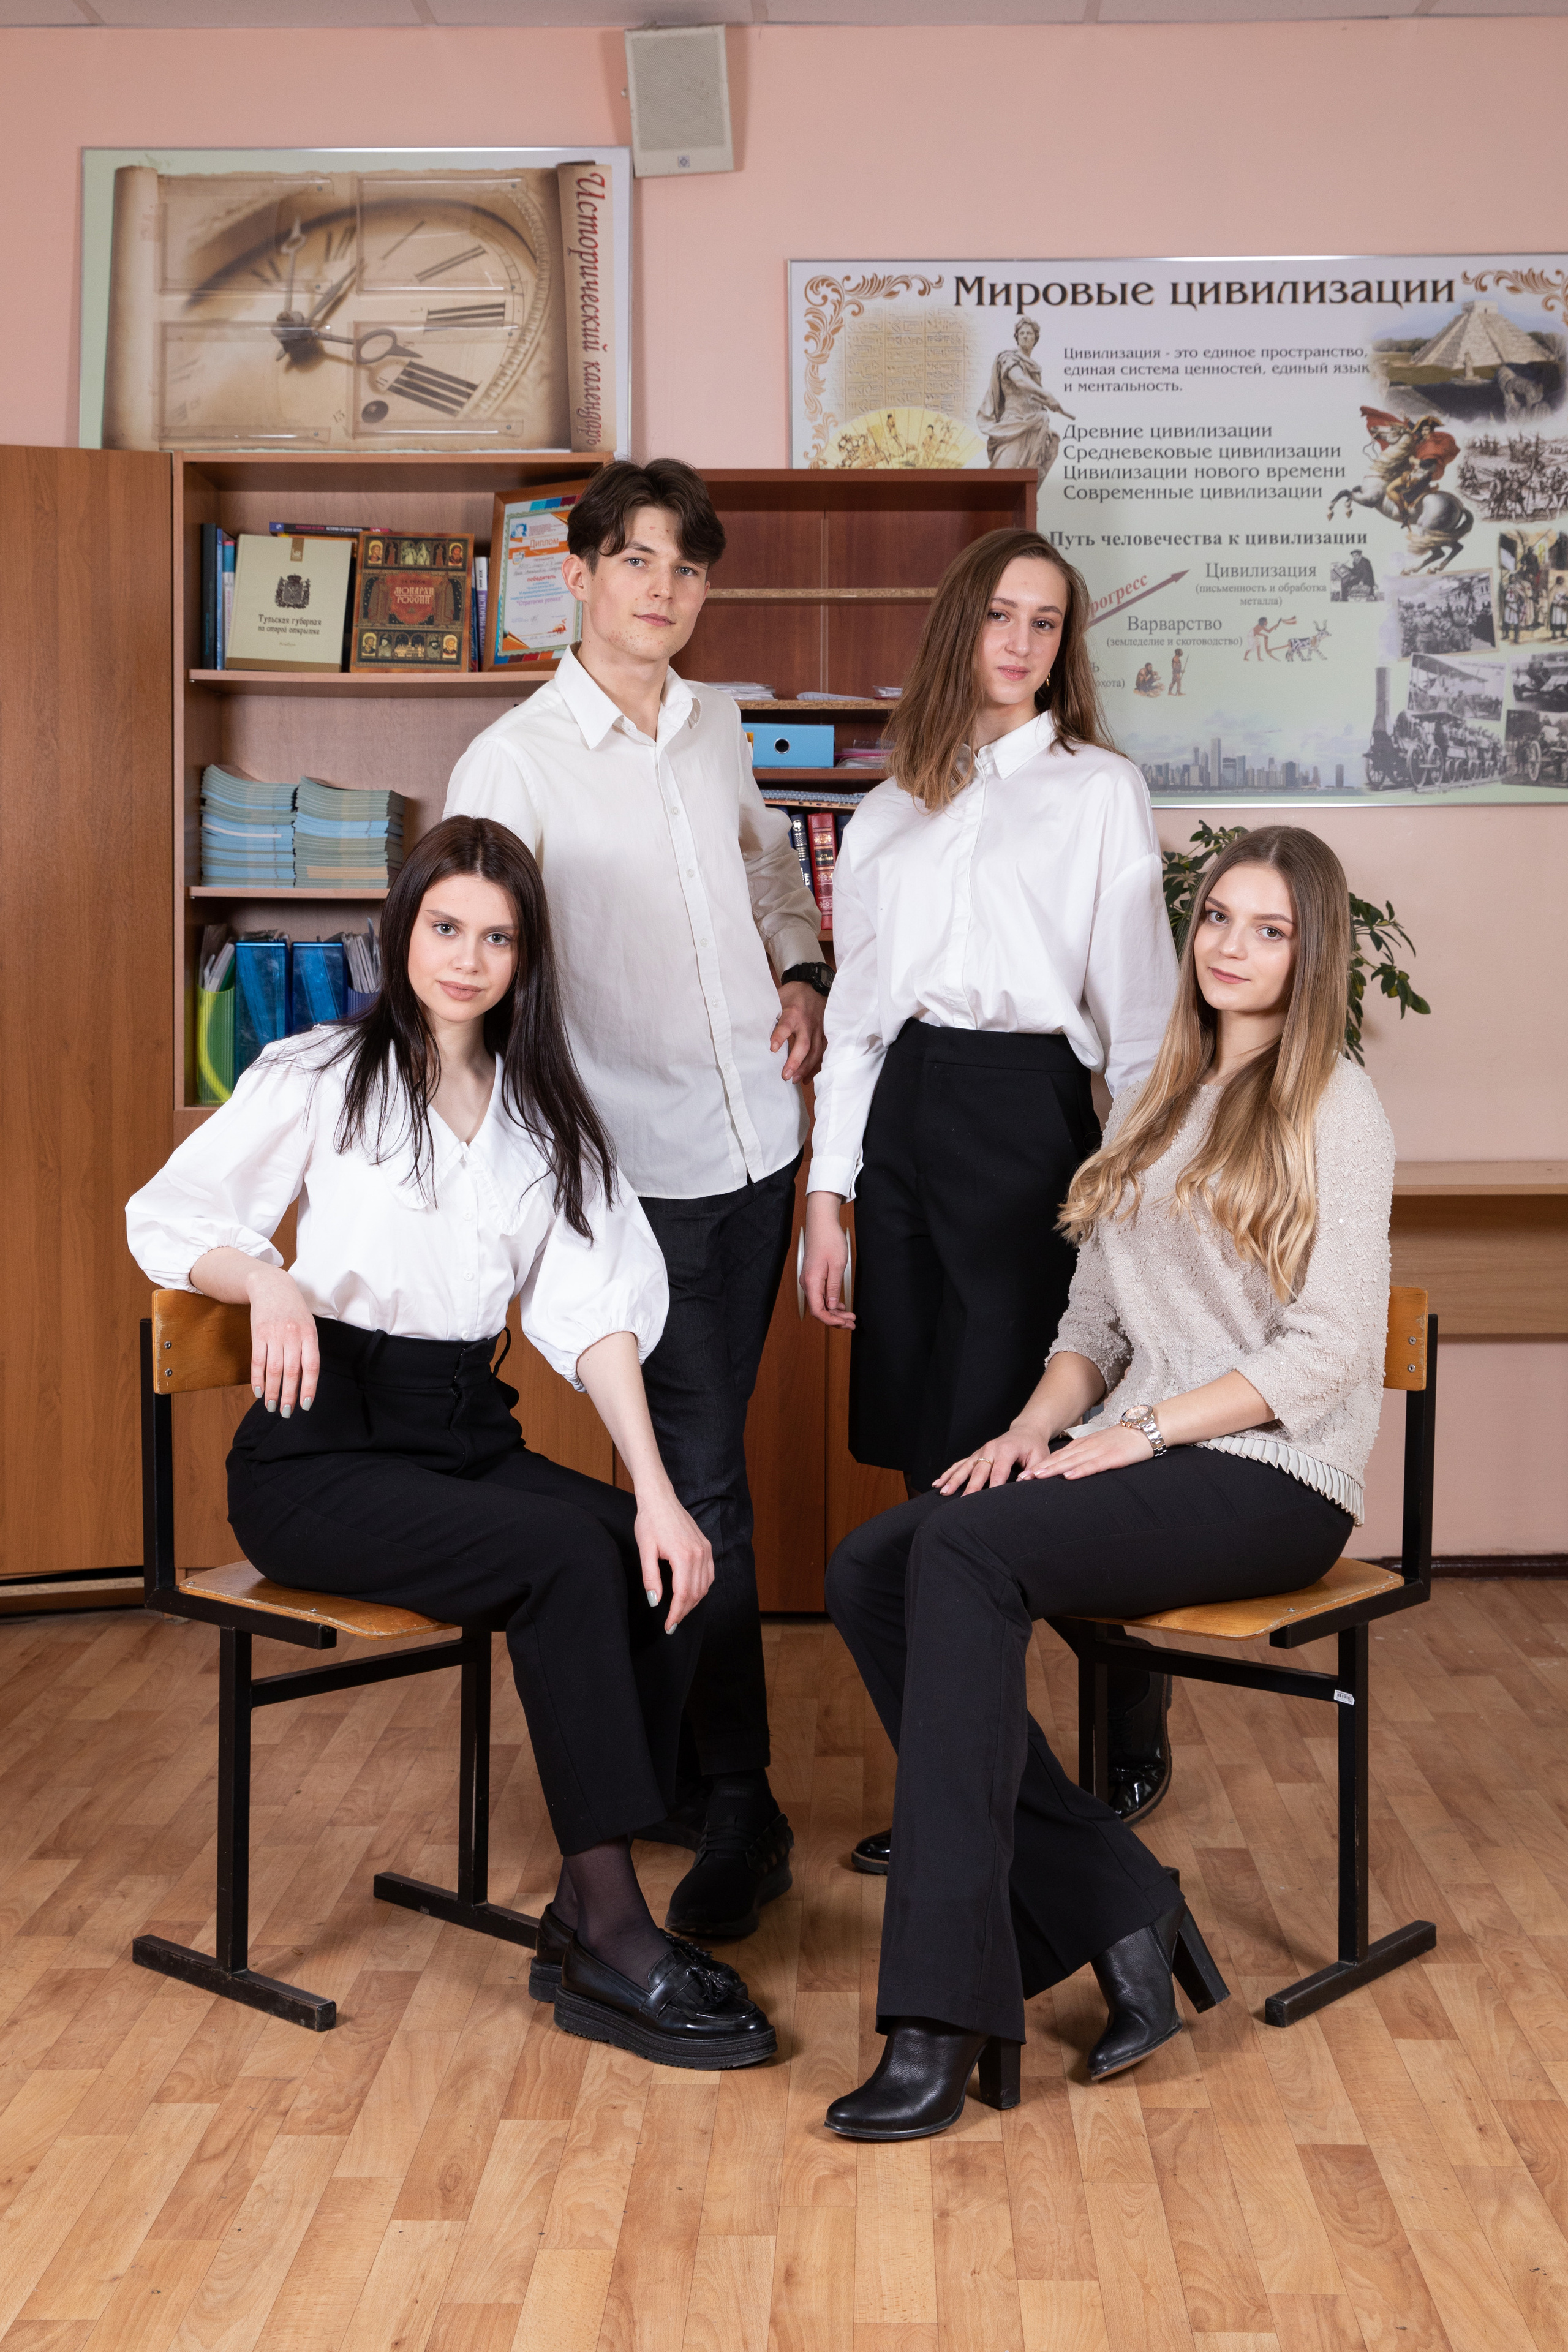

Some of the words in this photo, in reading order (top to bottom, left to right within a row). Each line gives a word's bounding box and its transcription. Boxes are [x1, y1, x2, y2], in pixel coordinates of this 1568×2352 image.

[567, 173, 608, 352] Исторический
[954, 276, 1154, 315] Мировые
[1170, 279, 1454, 309] цивилизации
[1064, 347, 1161, 360] Цивилизация
[1175, 349, 1199, 358] это
[1202, 349, 1256, 359] единое
[1261, 347, 1368, 361] пространство,
[1063, 366, 1115, 376] единая
[1120, 366, 1180, 375] система
[1185, 363, 1266, 375] ценностей,
[1271, 363, 1328, 375] единый
[1333, 364, 1371, 374] язык
[1064, 383, 1072, 392] и
[1078, 382, 1183, 392] ментальность.
[576, 360, 603, 445] календарь
[1062, 424, 1144, 441] Древние
[1150, 426, 1272, 439] цивилизации
[1063, 445, 1212, 462] Средневековые
[1219, 447, 1341, 459] цивилизации
[1064, 465, 1187, 481] Цивилизации
[1194, 467, 1260, 478] нового
[1267, 466, 1345, 482] времени
[1063, 484, 1193, 502] Современные
[1200, 487, 1322, 500] цивилизации
[1050, 531, 1095, 549] Путь
[1101, 534, 1222, 546] человечества
[1229, 534, 1240, 545] к
[1245, 533, 1367, 546] цивилизации
[1205, 562, 1316, 581] Цивилизация
[394, 586, 434, 595] МОНАРХИ
[1090, 575, 1148, 617] рогресс
[1195, 583, 1267, 595] (письменность
[1277, 582, 1327, 595] обработка
[397, 594, 431, 605] РОССИИ
[1240, 596, 1283, 607] металла)
[258, 614, 290, 624] Тульская
[1126, 615, 1223, 635] Варварство
[1105, 635, 1165, 647] (земледелие
[1175, 635, 1243, 647] скотоводство)
